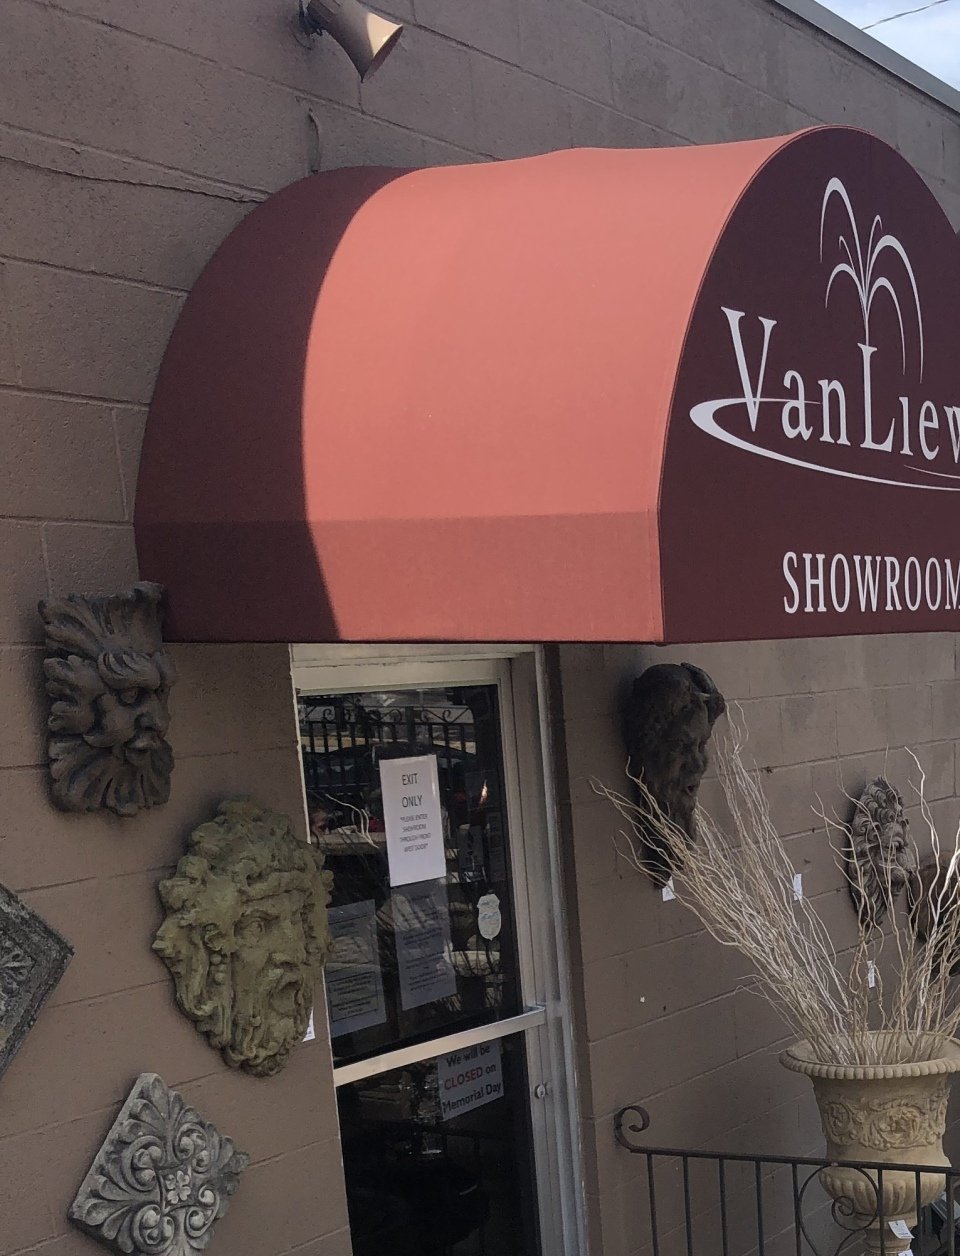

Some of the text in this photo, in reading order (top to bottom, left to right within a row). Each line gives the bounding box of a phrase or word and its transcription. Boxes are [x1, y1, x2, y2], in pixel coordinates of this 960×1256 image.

[402, 772, 418, 786] EXIT
[402, 795, 423, 808] ONLY
[446, 1045, 490, 1067] We will be
[444, 1064, 496, 1091] CLOSED on
[442, 1083, 502, 1113] Memorial Day
